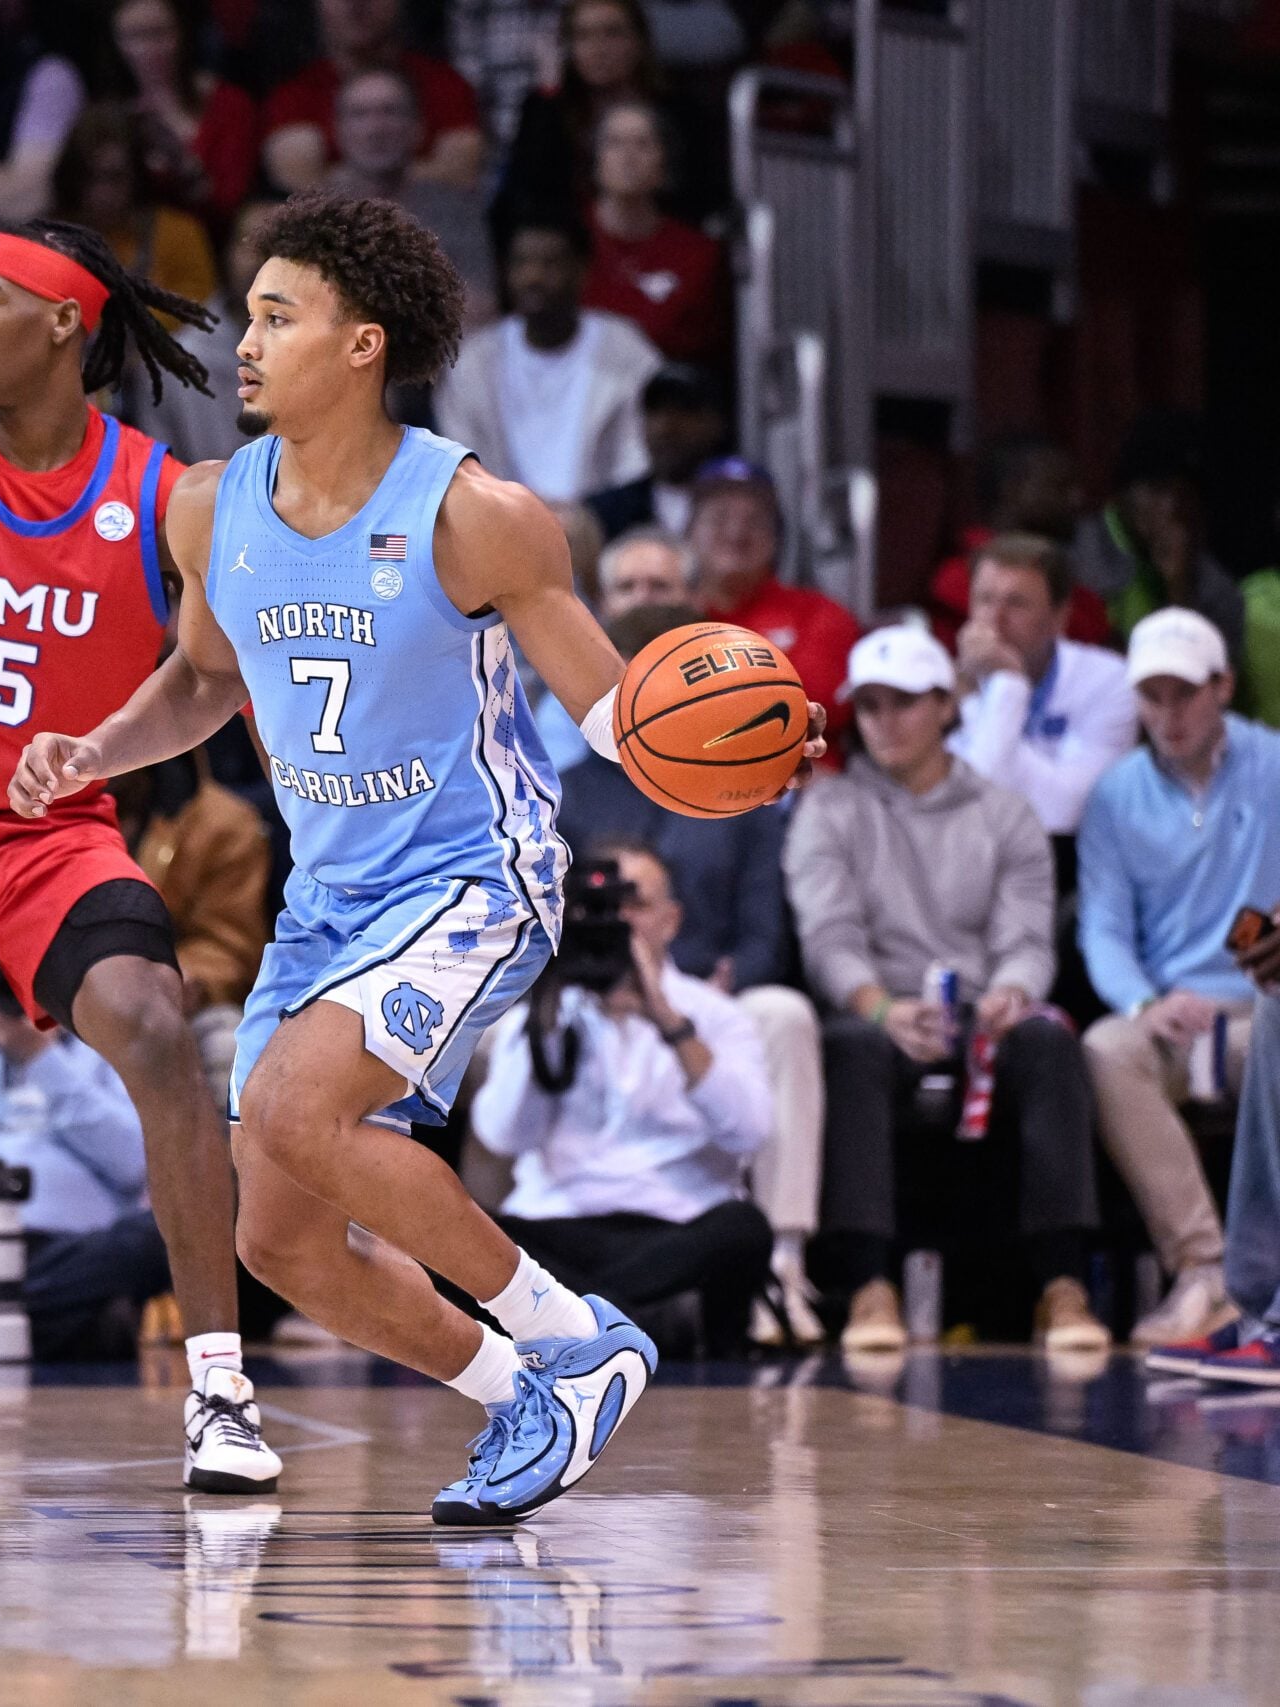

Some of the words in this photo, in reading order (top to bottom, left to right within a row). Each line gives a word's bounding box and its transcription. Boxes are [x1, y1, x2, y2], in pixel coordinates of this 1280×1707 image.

[256, 602, 376, 647] NORTH
[678, 648, 778, 686] ELITE
[289, 657, 352, 754] 7
[270, 755, 436, 807] CAROLINA
